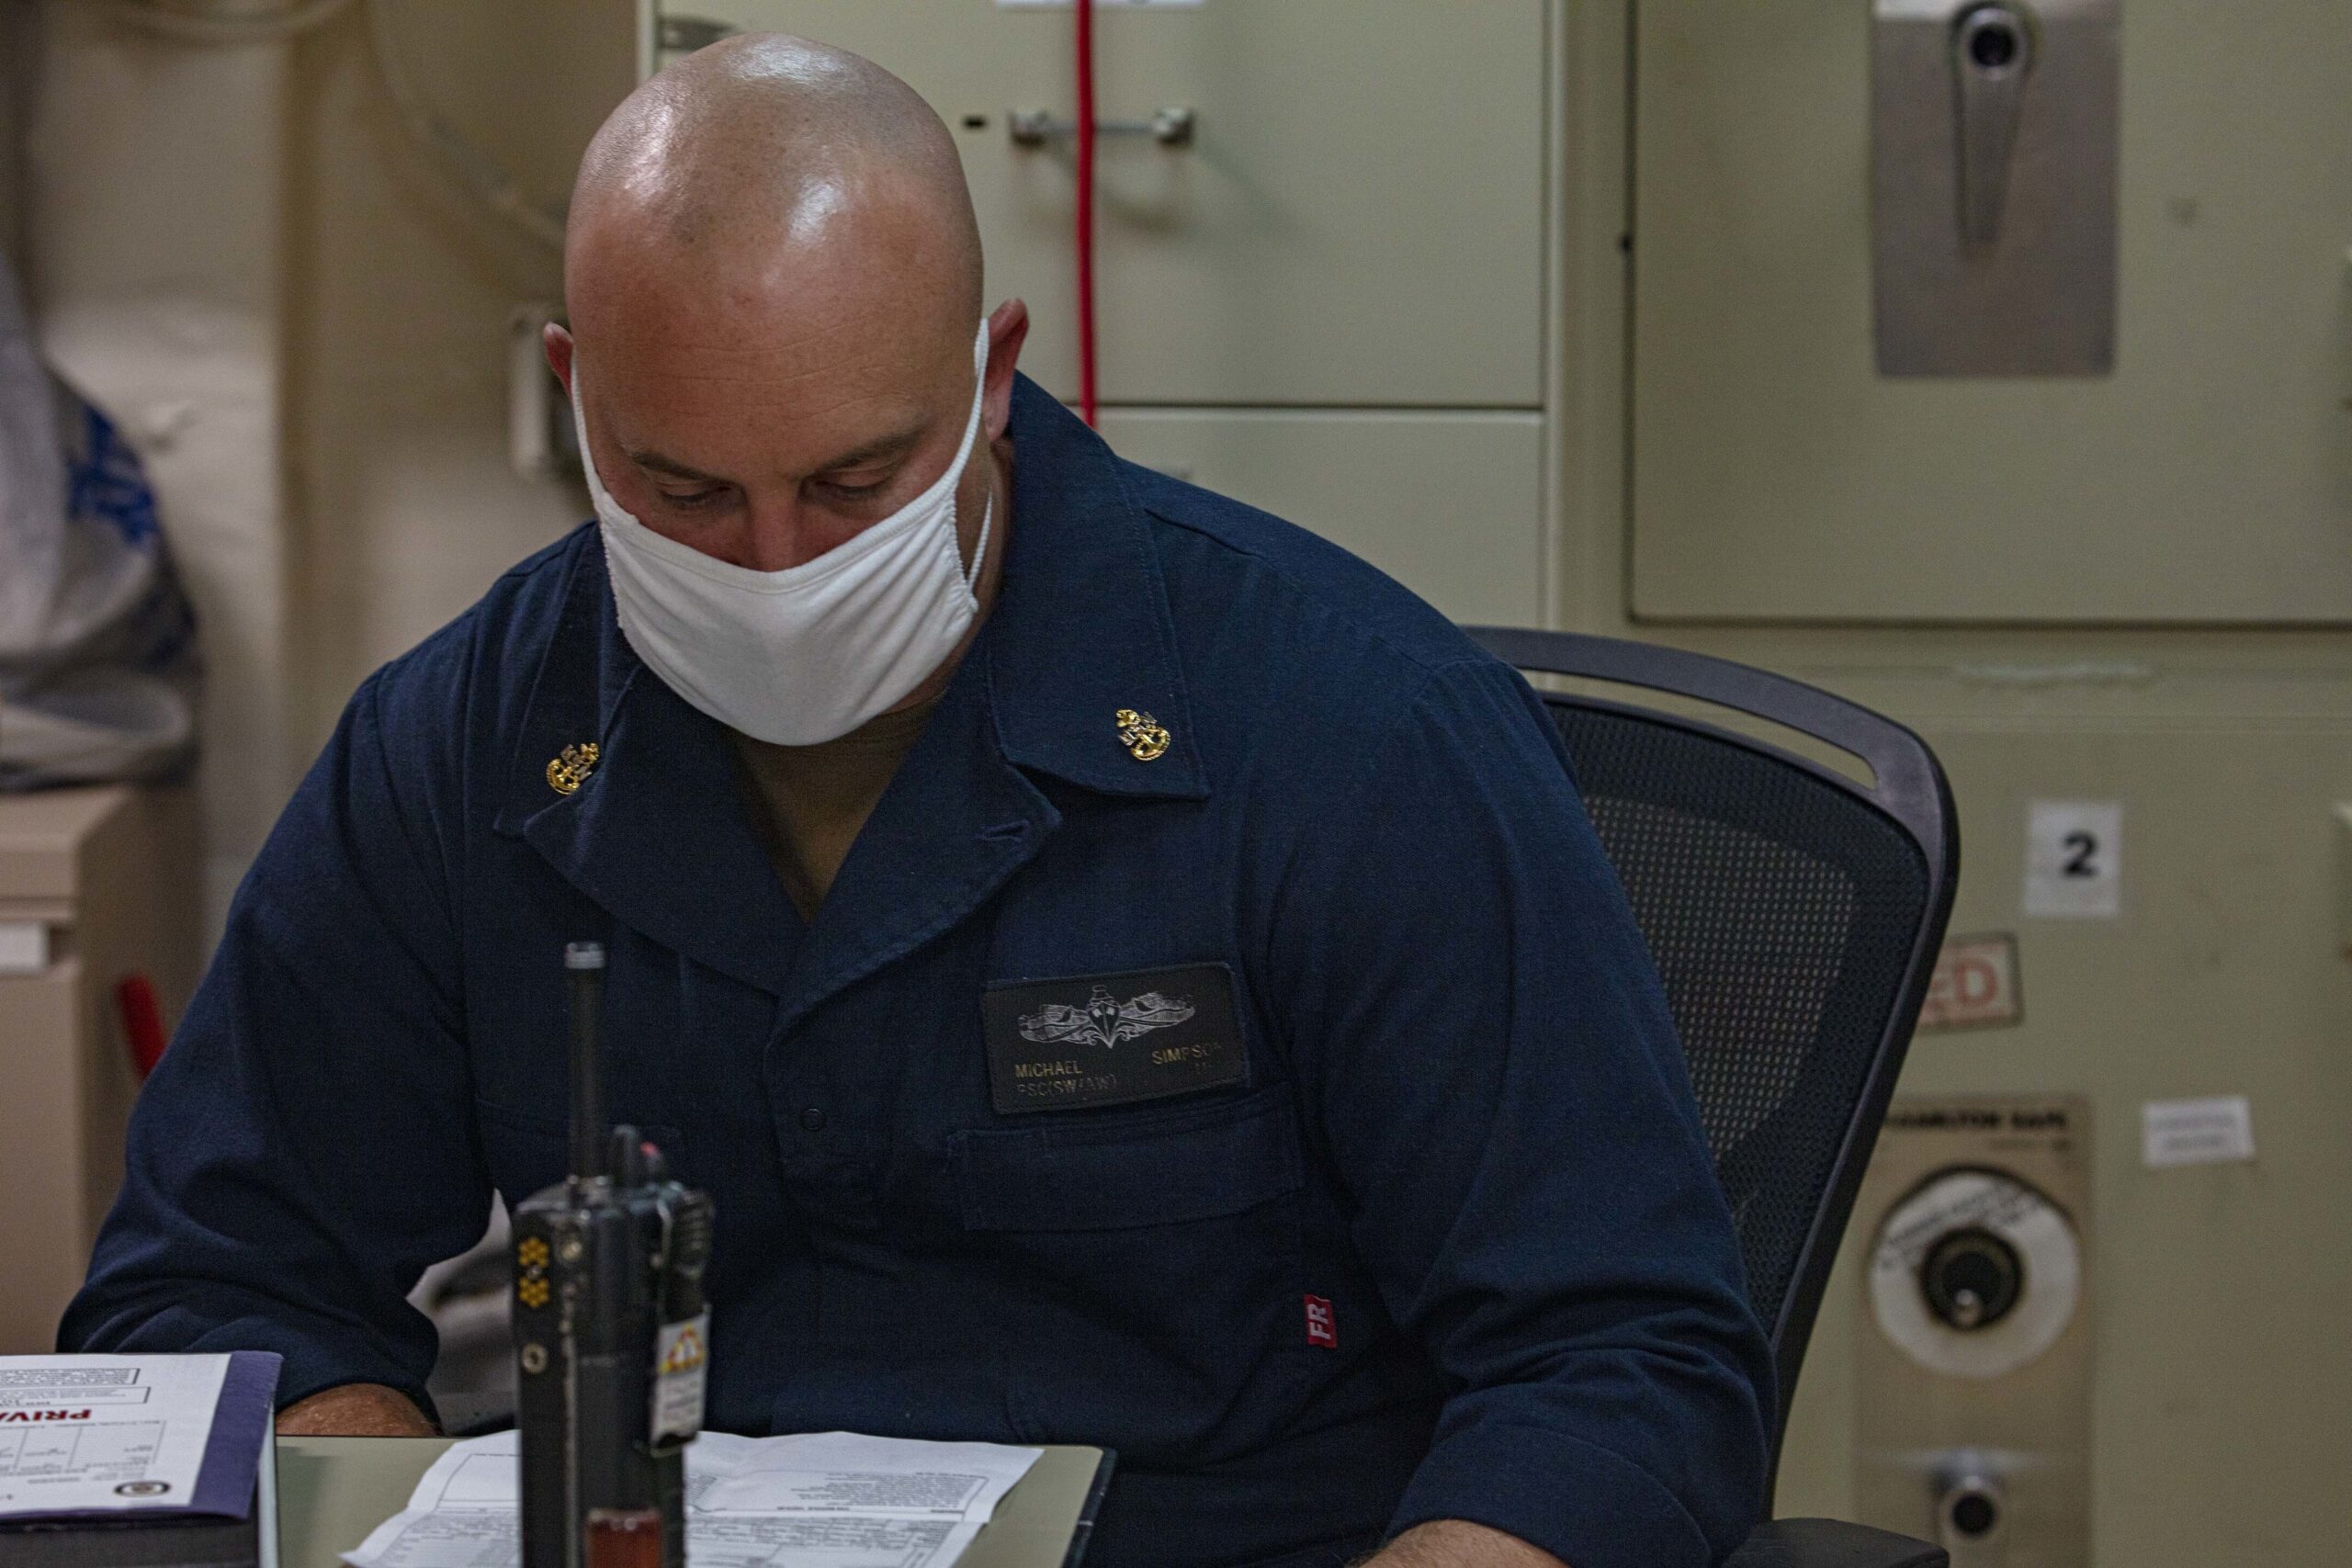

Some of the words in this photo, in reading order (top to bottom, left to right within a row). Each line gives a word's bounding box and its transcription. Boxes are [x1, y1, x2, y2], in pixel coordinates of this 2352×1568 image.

[2062, 830, 2098, 877] 2
[1014, 1060, 1083, 1077] MICHAEL
[1307, 1303, 1331, 1340] FR
